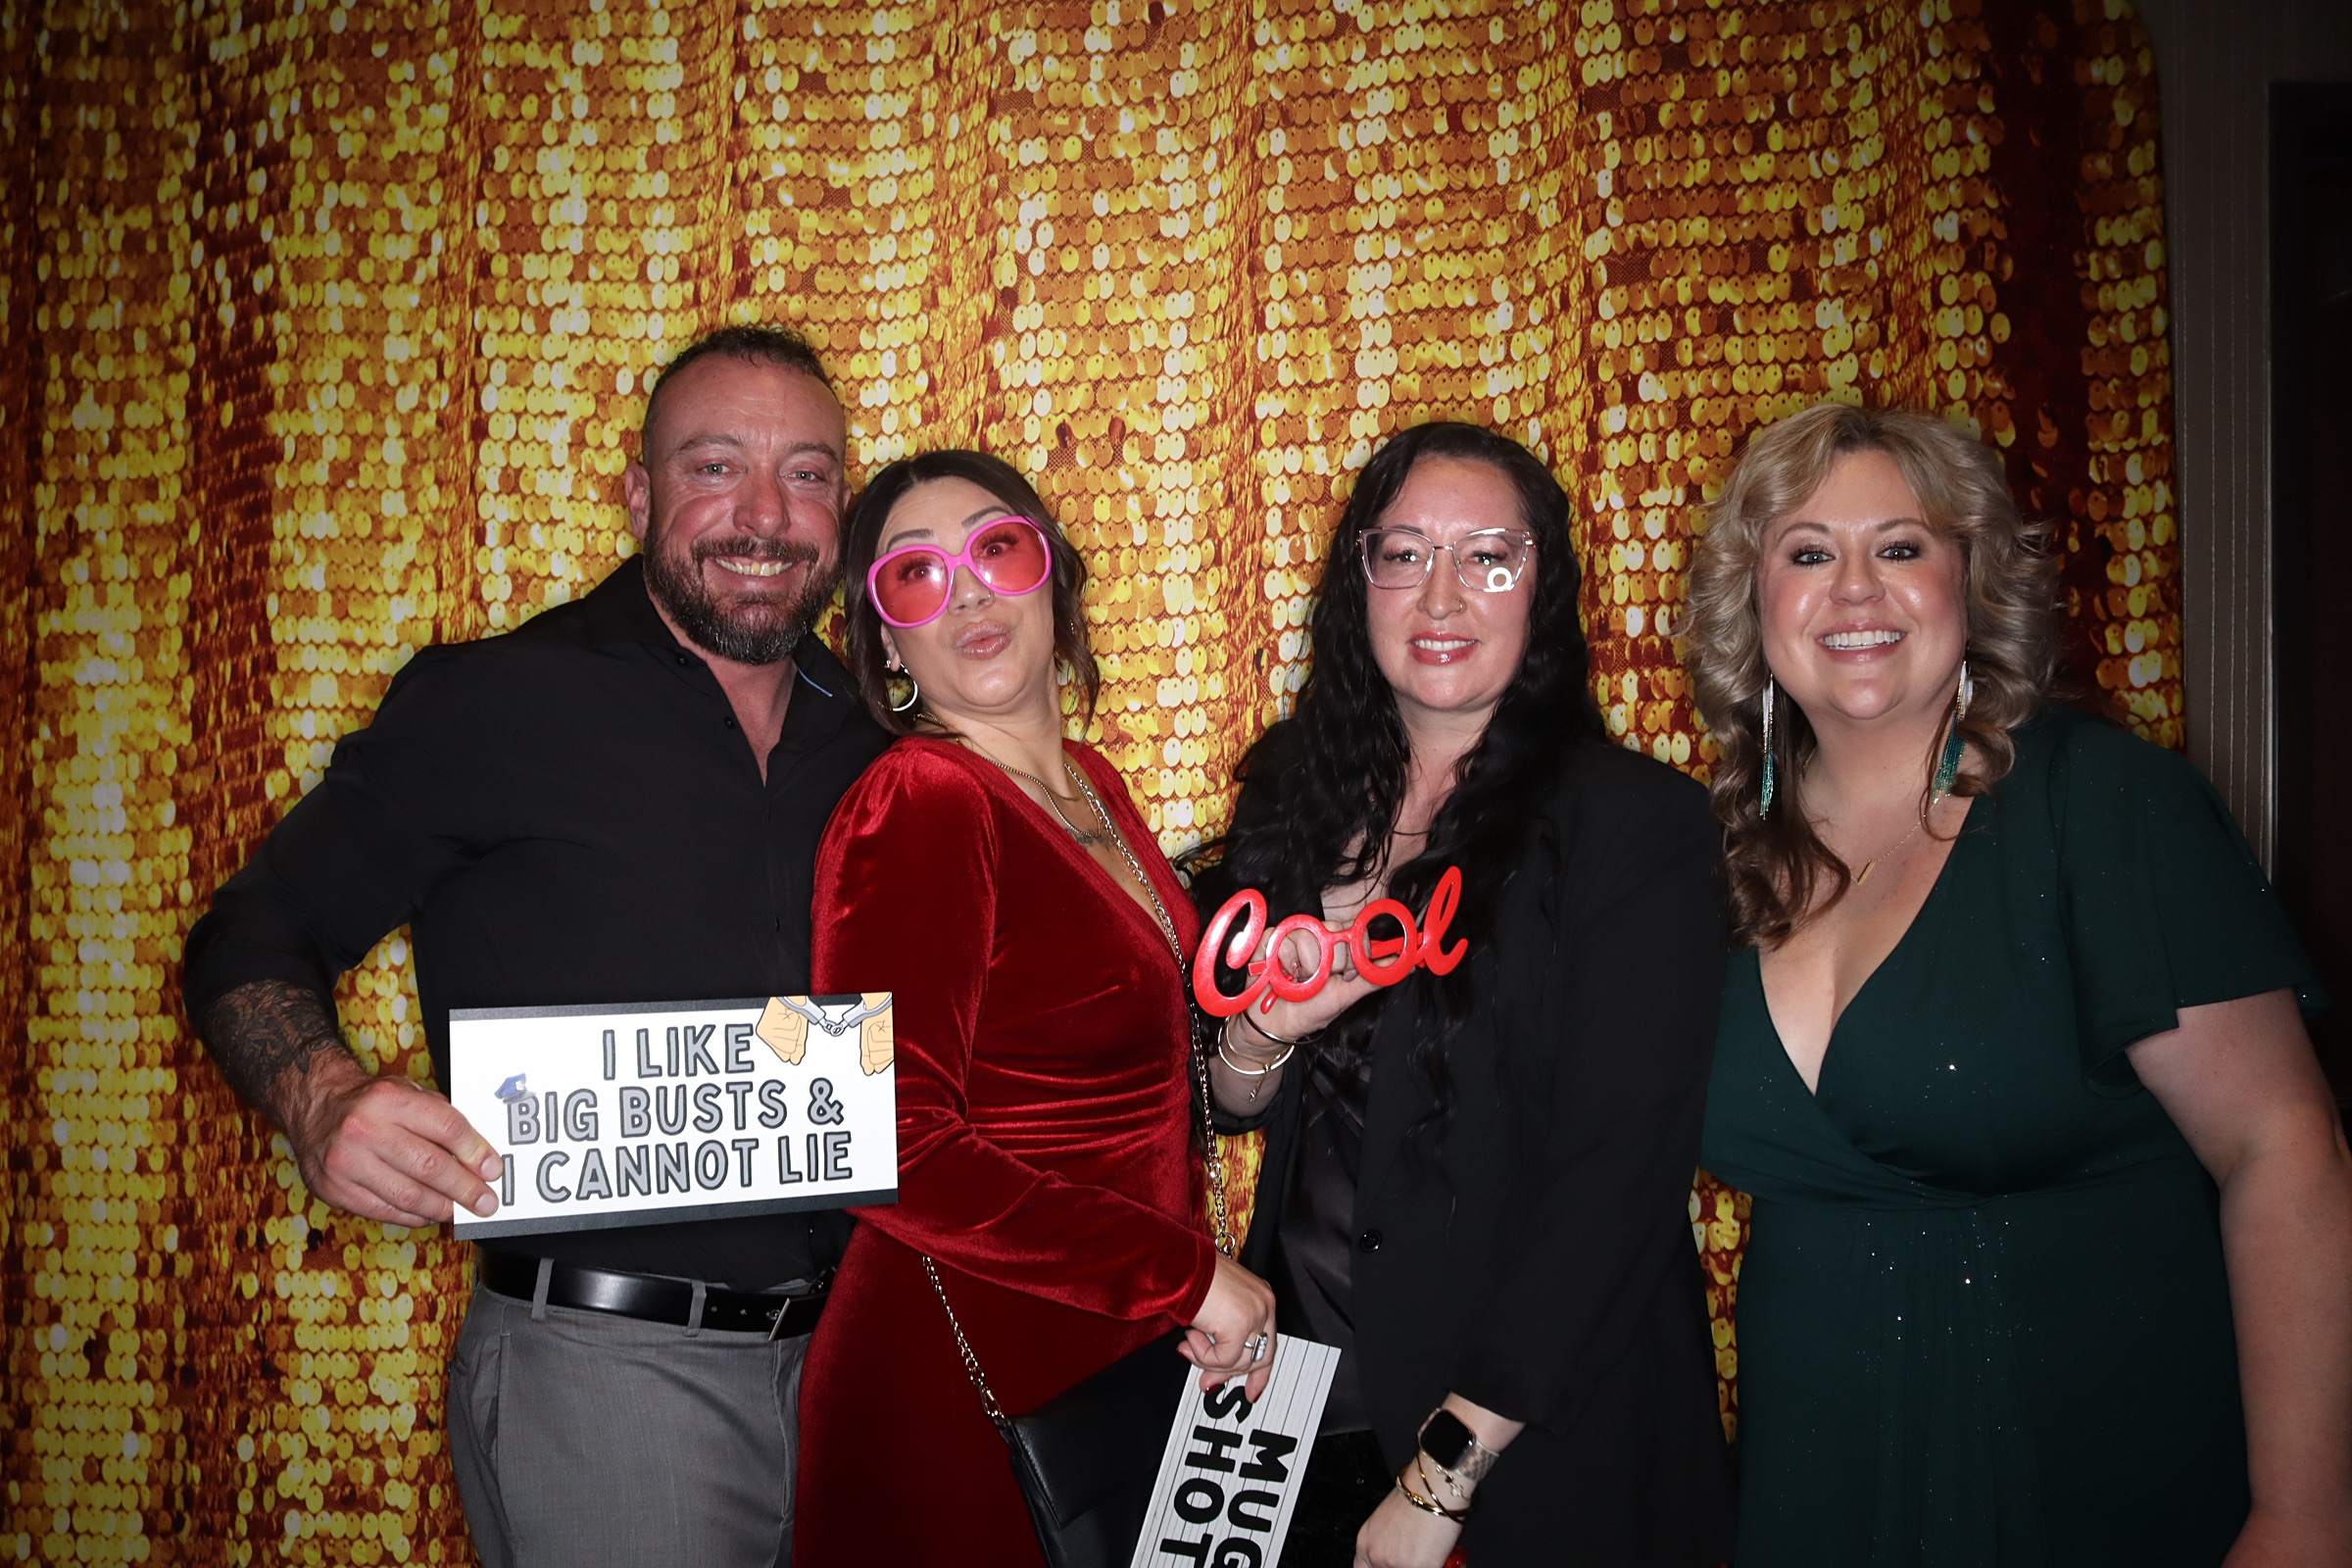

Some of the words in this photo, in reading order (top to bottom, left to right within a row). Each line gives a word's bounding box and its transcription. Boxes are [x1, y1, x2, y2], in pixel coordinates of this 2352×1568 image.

[1193, 865, 1468, 1017] Cool
[603, 1029, 615, 1080] I
[637, 1023, 755, 1078] LIKE
[508, 1089, 599, 1146] BIG
[619, 1079, 787, 1138] BUSTS
[808, 1078, 844, 1125] &
[502, 1153, 514, 1205] I
[536, 1139, 759, 1203] CANNOT
[778, 1131, 852, 1184] LIE
[1159, 1384, 1253, 1568] SHOT
[1211, 1429, 1298, 1568] MUG
